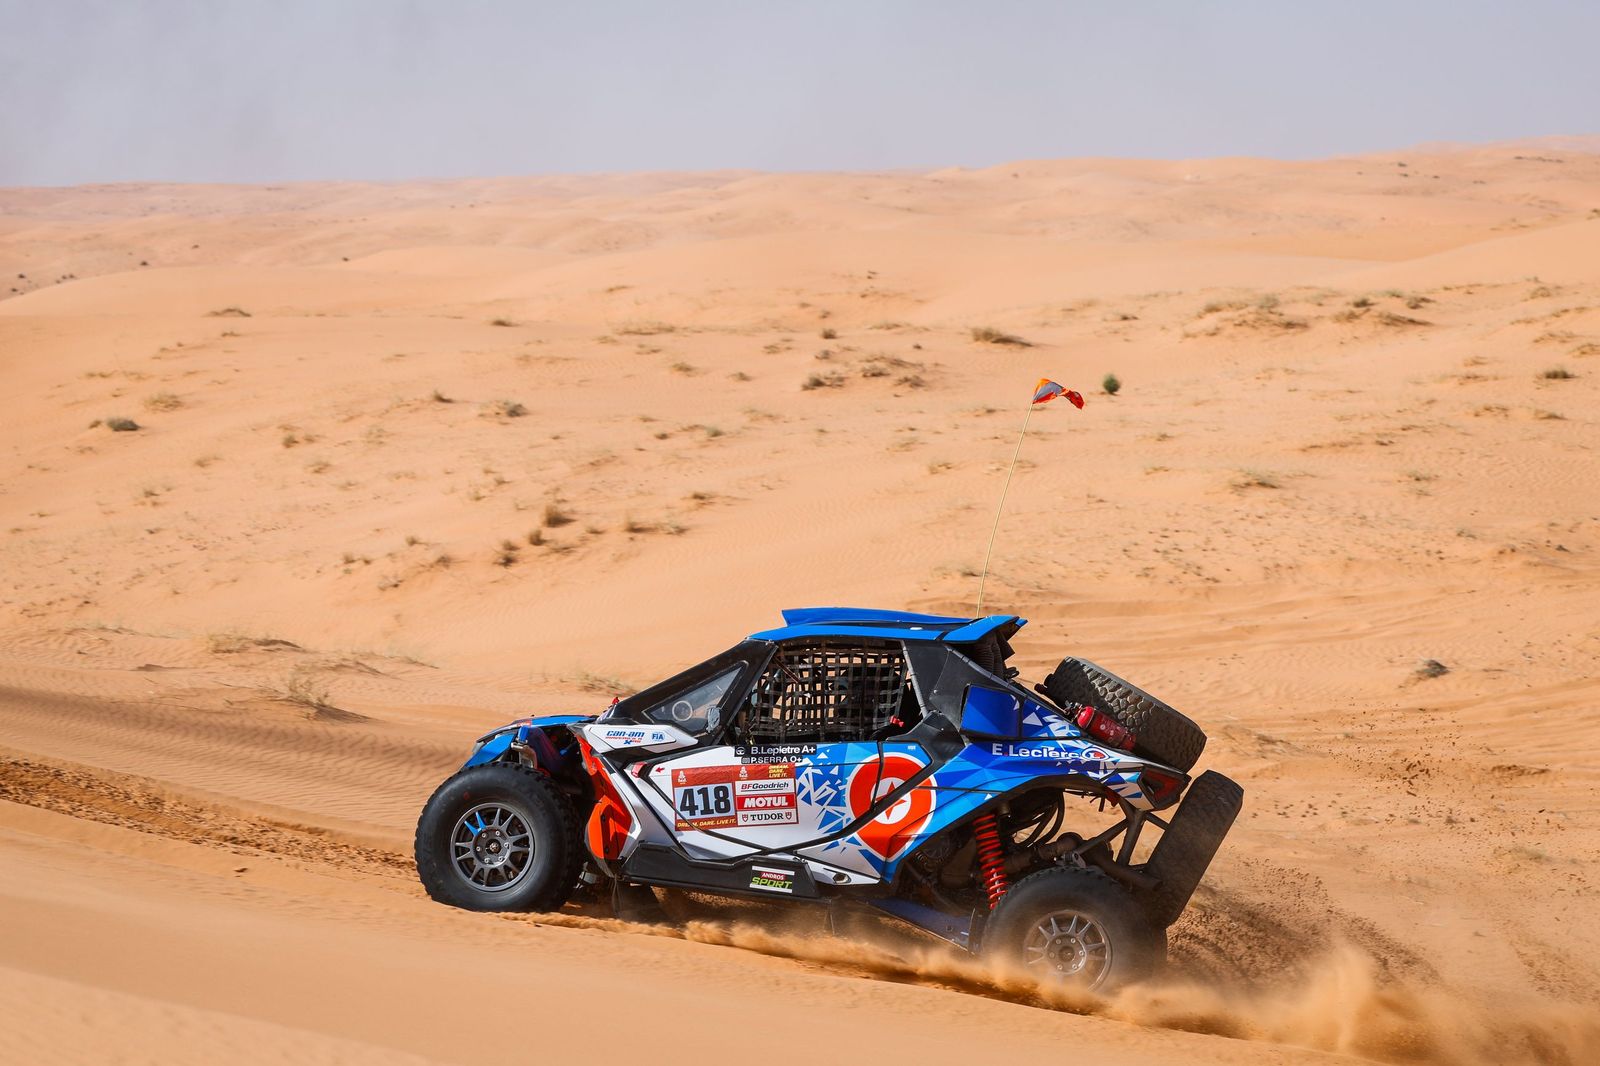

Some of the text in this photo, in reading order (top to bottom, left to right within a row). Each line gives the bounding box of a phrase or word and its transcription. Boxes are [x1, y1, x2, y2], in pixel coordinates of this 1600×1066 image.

[801, 745, 816, 754] A+
[991, 743, 1080, 758] E.Leclerc
[741, 782, 788, 790] BFGoodrich
[680, 785, 731, 816] 418
[744, 796, 788, 808] MOTUL
[750, 813, 784, 821] TUDOR
[761, 872, 784, 880] ANDROS
[751, 877, 792, 889] SPORT
